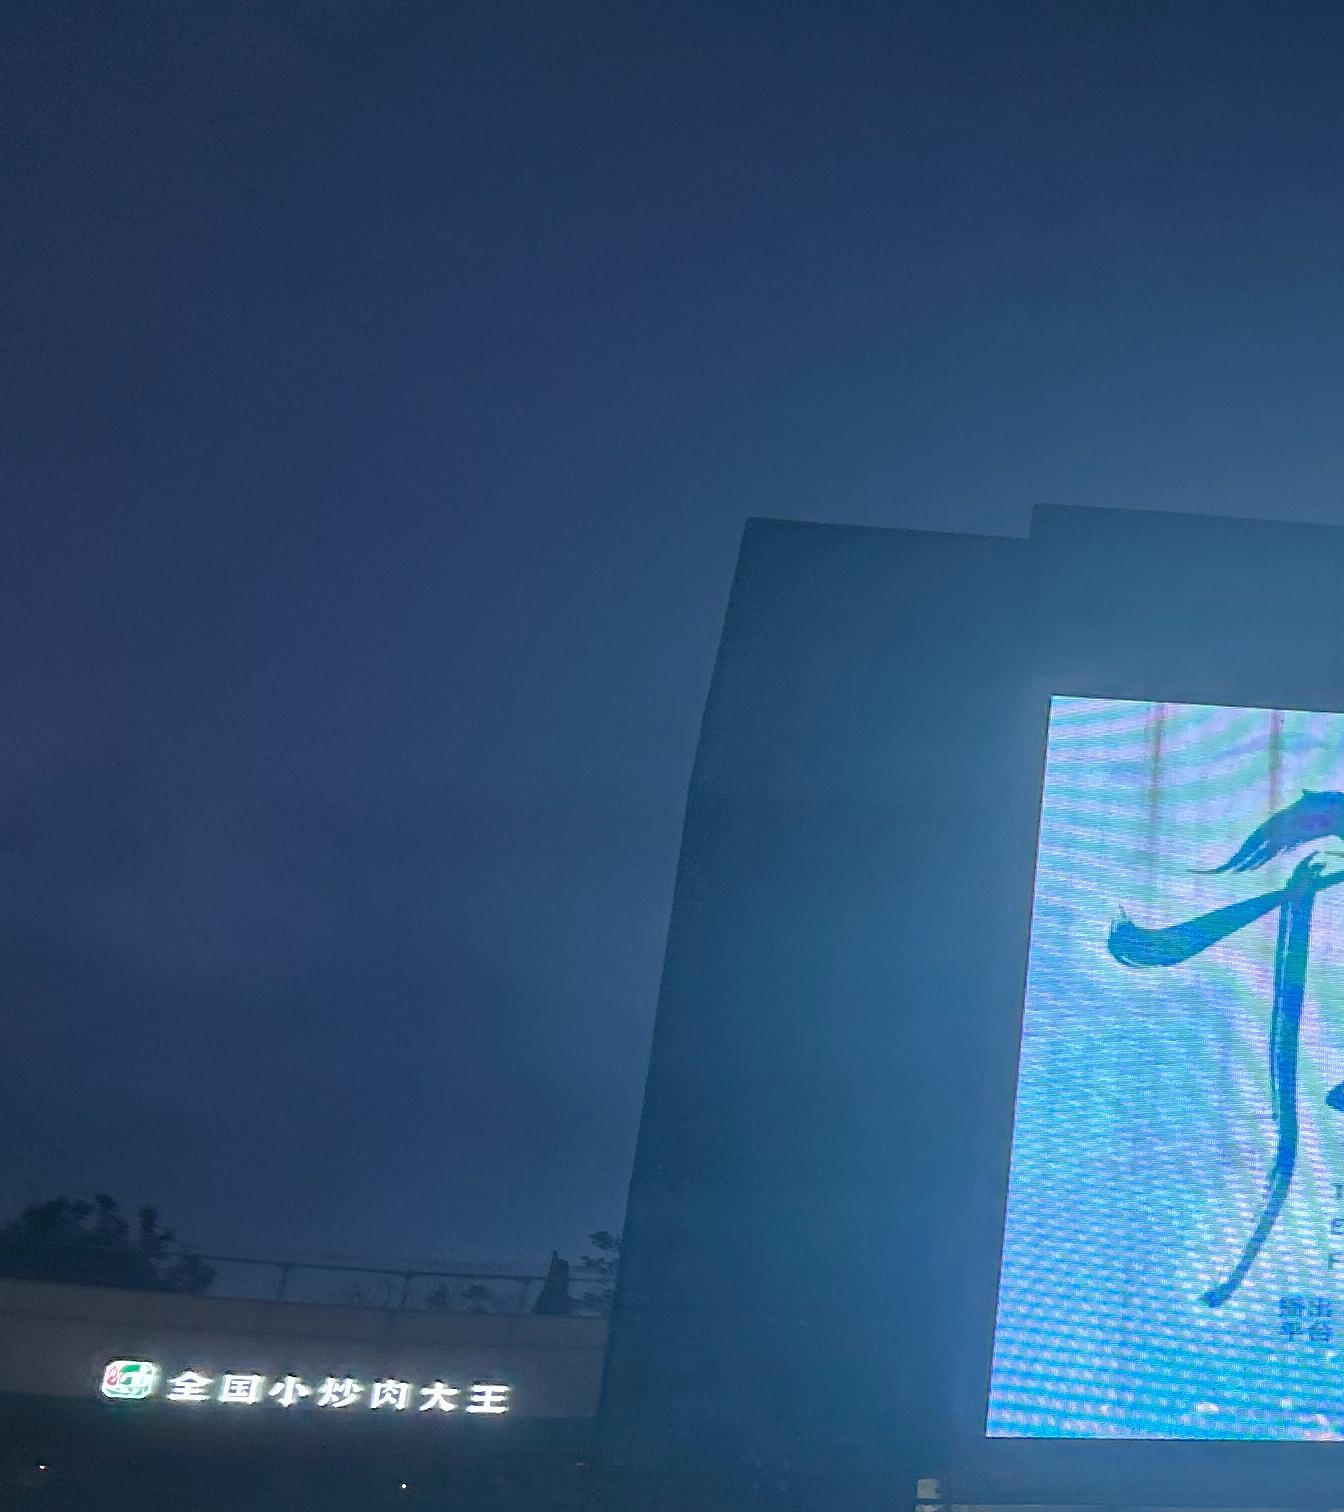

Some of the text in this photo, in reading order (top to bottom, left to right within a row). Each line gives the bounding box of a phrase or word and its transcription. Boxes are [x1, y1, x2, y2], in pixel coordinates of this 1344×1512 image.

[167, 1370, 511, 1414] 全国小炒肉大王
